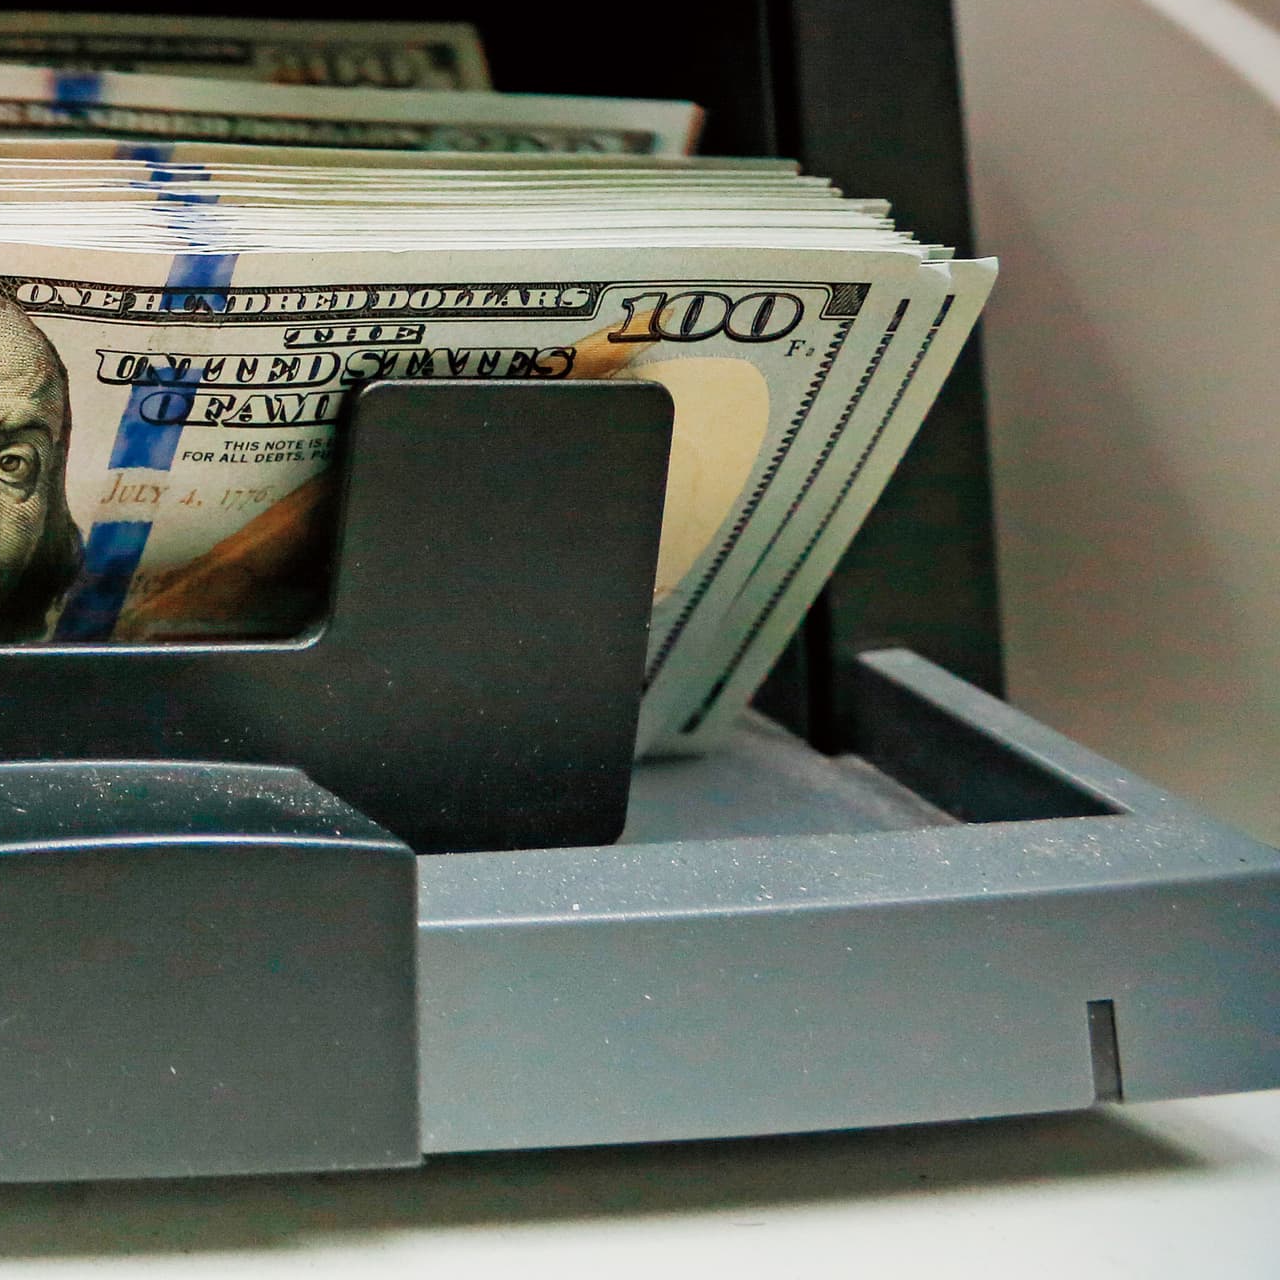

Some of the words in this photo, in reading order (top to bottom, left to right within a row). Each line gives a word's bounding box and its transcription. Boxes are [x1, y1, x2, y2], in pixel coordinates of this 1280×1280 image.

[16, 283, 123, 312] ONE
[125, 288, 369, 314] HUNDRED
[371, 287, 592, 310] DOLLARS
[607, 290, 804, 343] 100
[284, 323, 426, 349] THE
[95, 349, 340, 390] UNITED
[340, 346, 577, 386] STATES
[182, 451, 213, 463] FOR
[219, 451, 248, 463] ALL
[224, 441, 260, 452] THIS
[264, 440, 303, 452] NOTE
